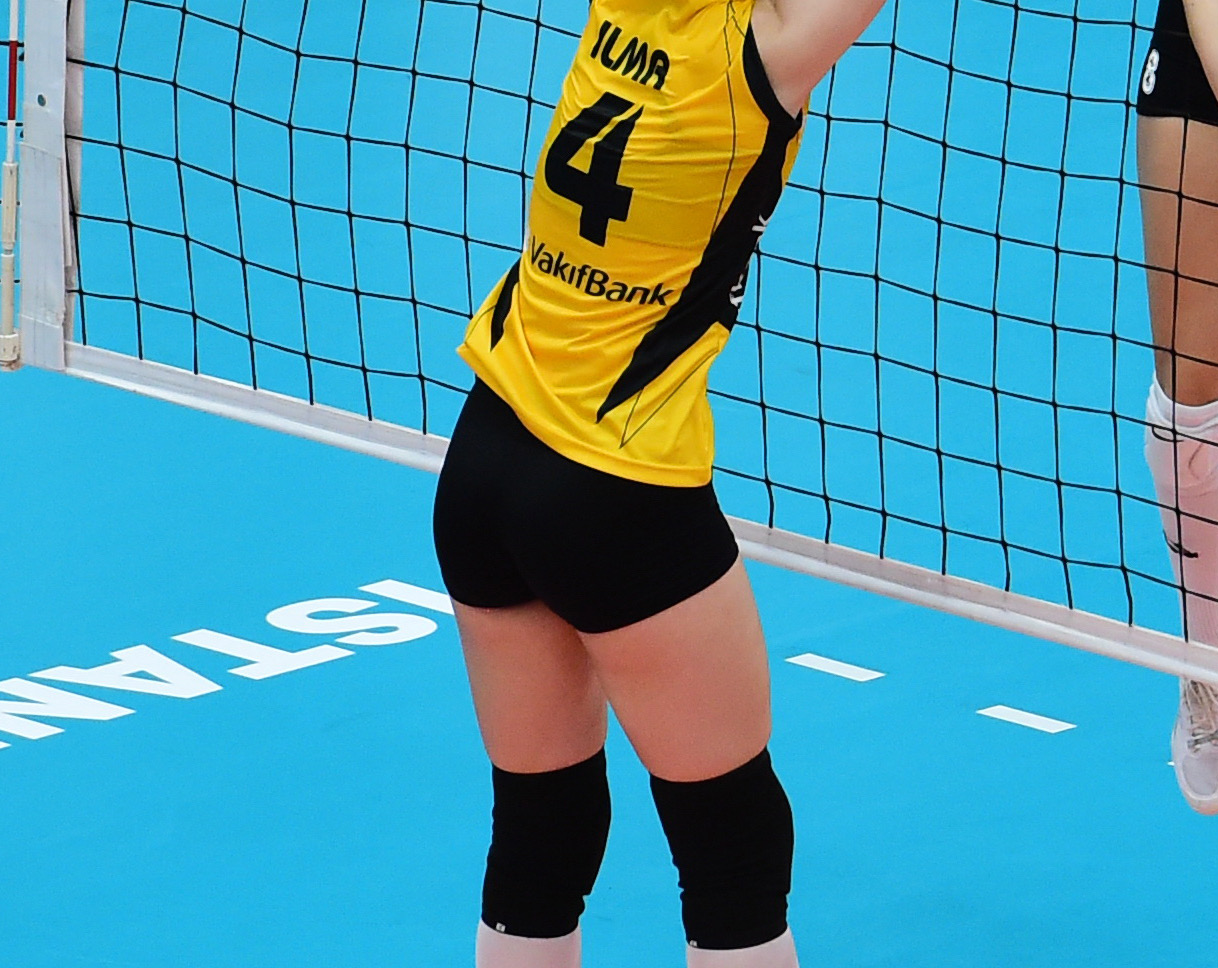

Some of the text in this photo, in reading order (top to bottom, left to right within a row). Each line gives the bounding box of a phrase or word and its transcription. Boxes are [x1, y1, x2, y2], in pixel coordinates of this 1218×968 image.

[590, 20, 670, 90] ILMA
[1142, 48, 1160, 95] 8
[544, 91, 644, 248] 4
